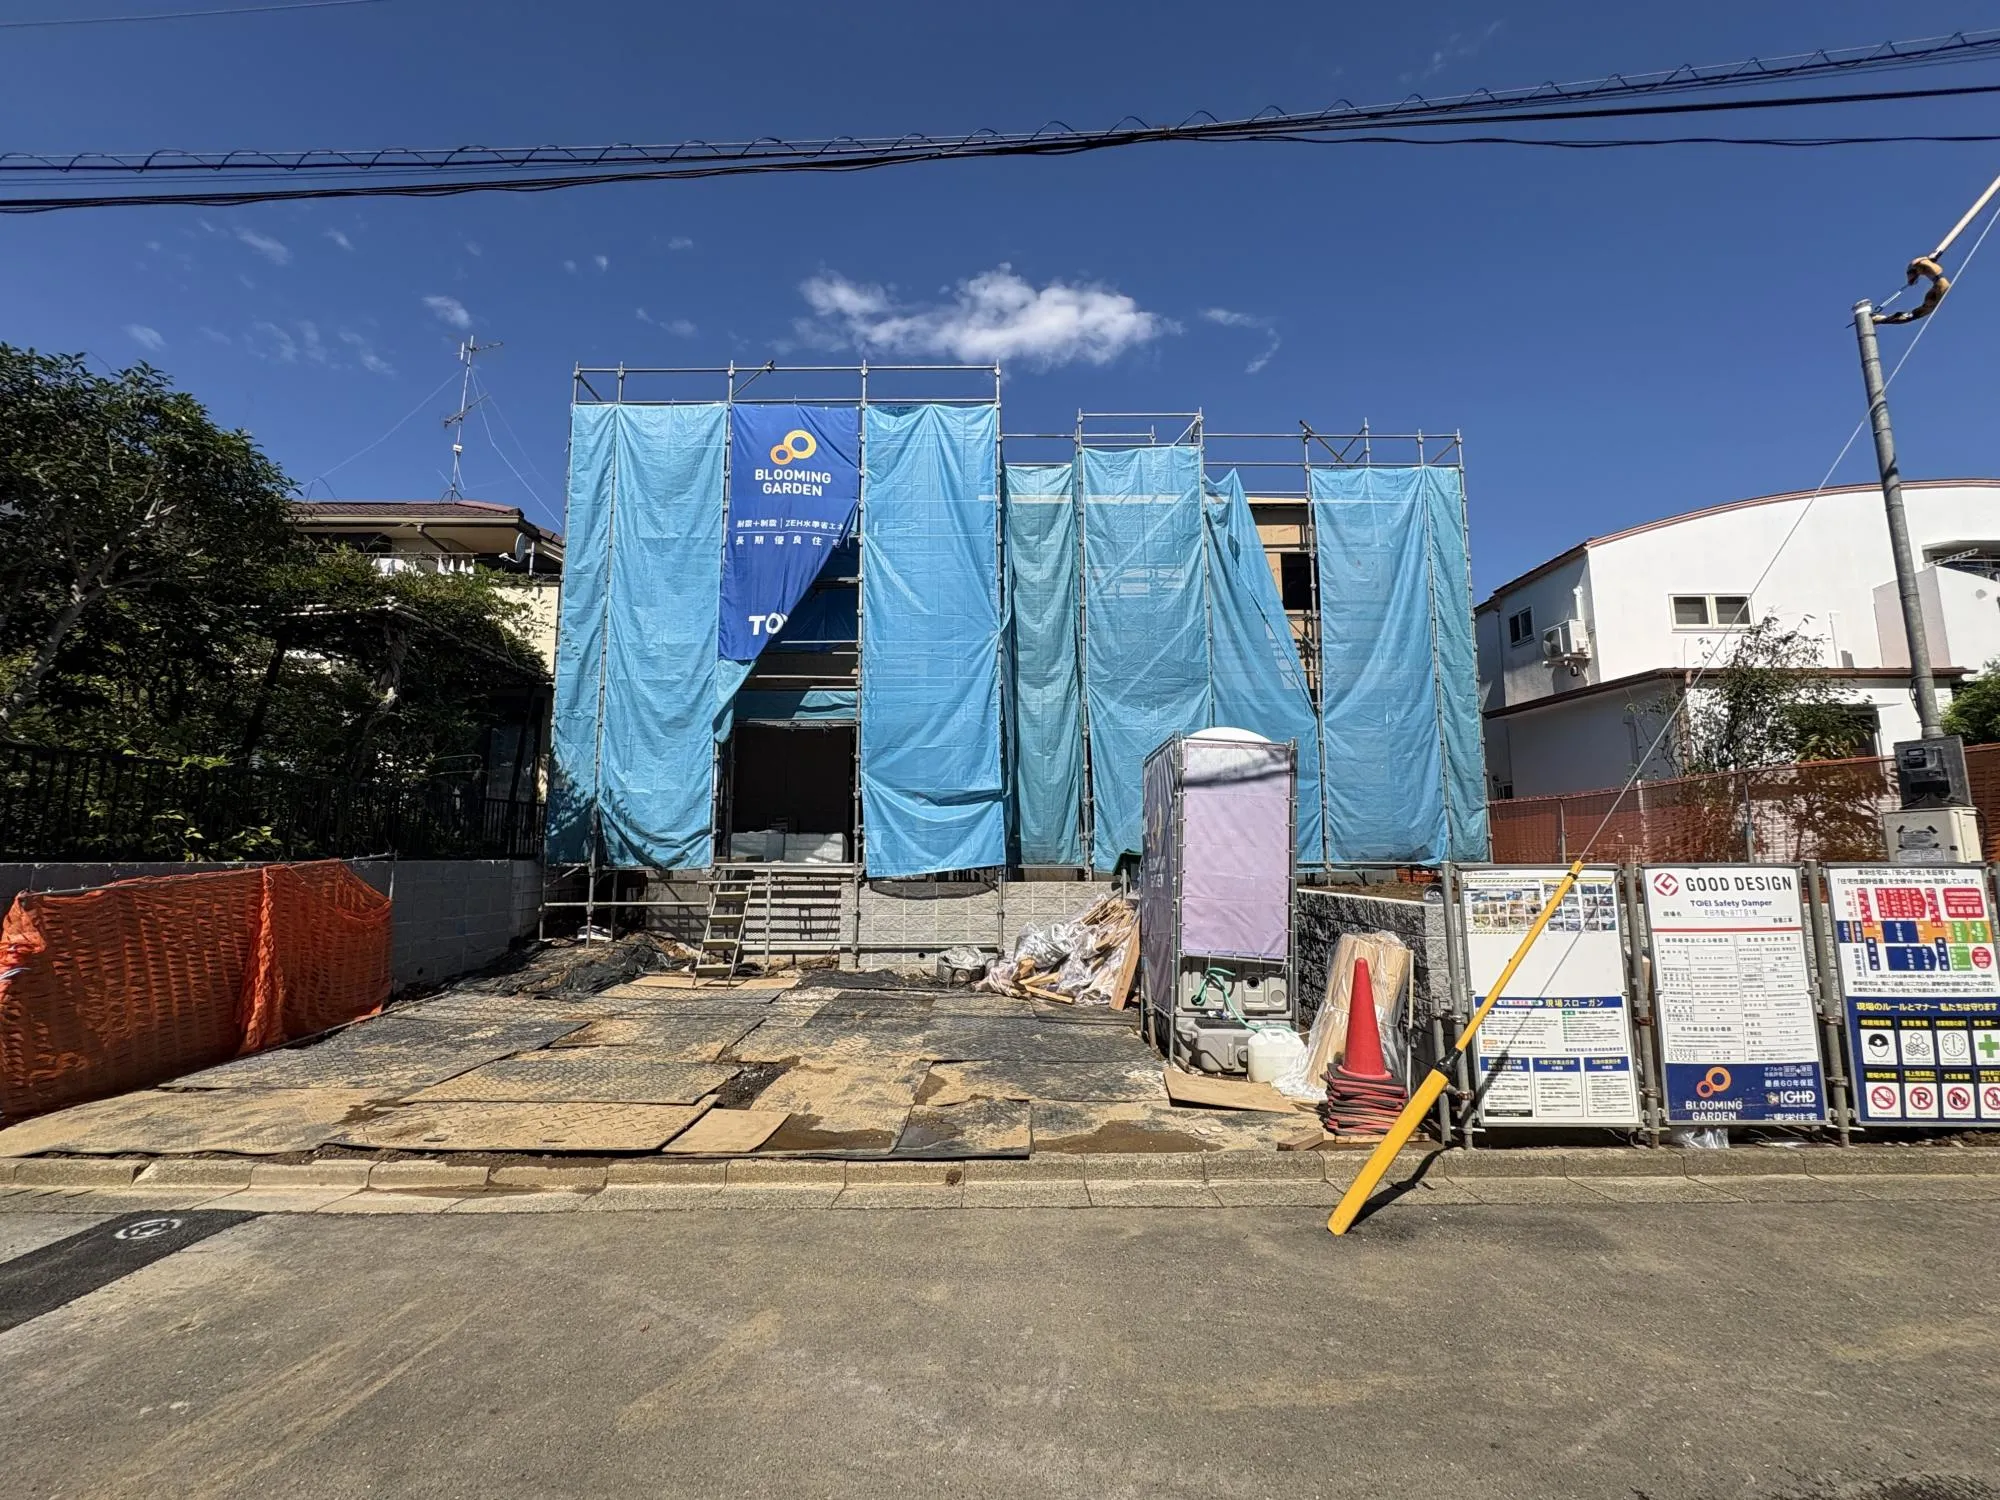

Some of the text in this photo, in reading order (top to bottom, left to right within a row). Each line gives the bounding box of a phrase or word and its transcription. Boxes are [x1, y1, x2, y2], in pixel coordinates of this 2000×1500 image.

[755, 468, 832, 484] BLOOMING
[762, 482, 823, 497] GARDEN
[748, 612, 789, 636] TO
[1685, 876, 1792, 892] GOOD DESIGN
[1714, 899, 1740, 908] Safety
[1742, 899, 1773, 908] Damper
[1545, 998, 1604, 1008] 現場スローガン
[1856, 1002, 1998, 1011] 現場のルールとマナー 私たちは守ります
[1685, 1100, 1743, 1110] BLOOMING
[1692, 1111, 1737, 1121] GARDEN
